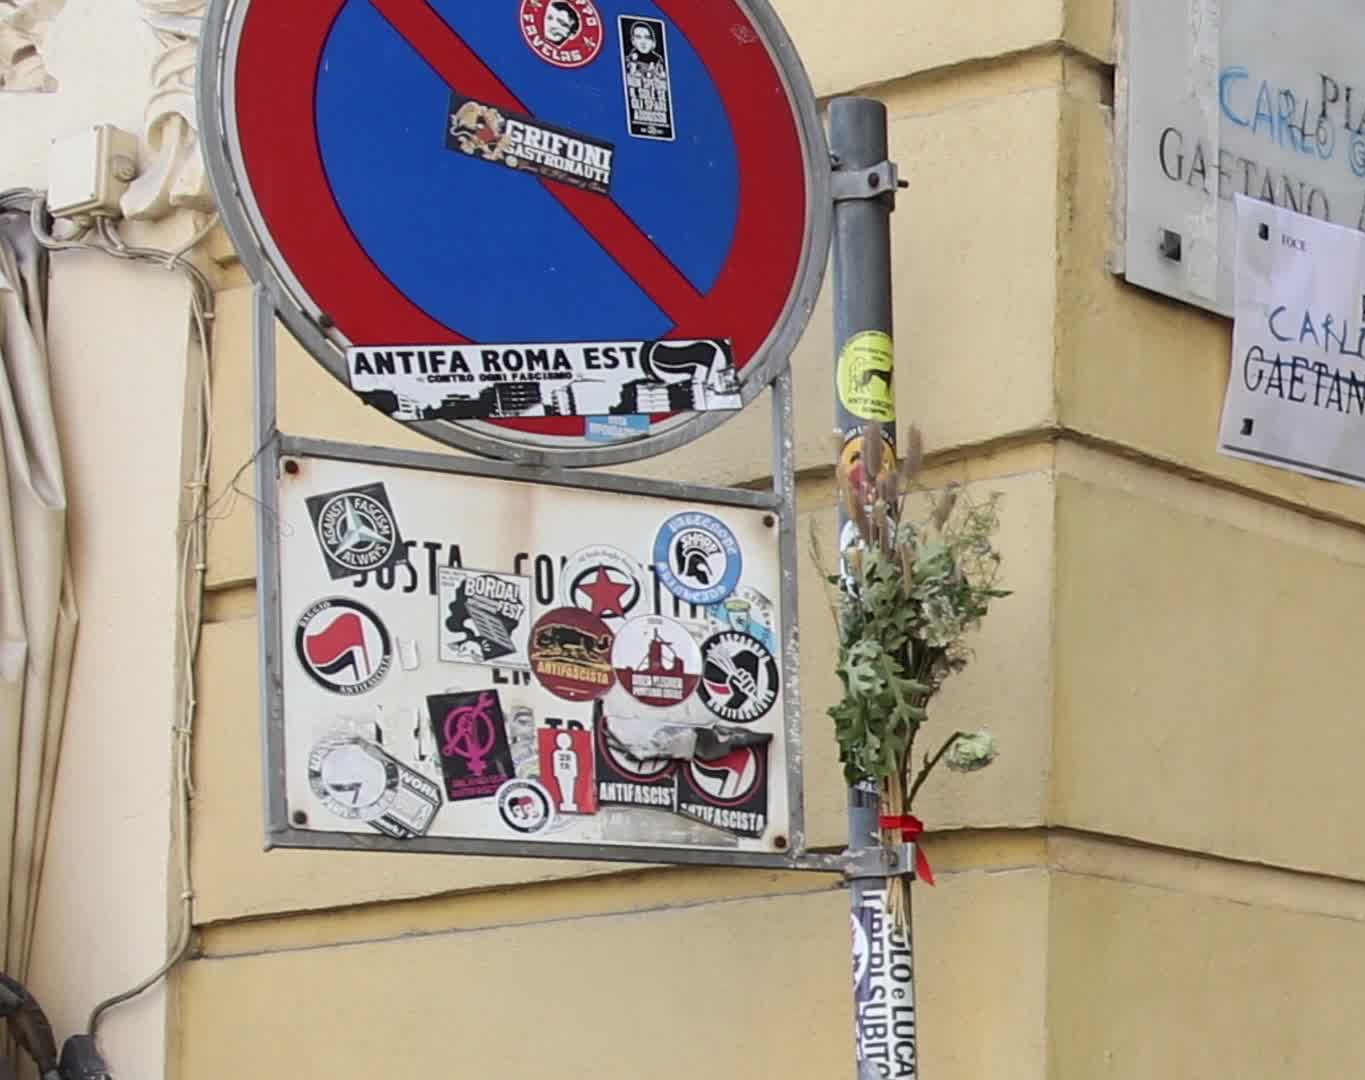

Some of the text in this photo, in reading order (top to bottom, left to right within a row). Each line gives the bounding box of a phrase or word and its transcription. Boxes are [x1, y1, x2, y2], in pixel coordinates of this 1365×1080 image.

[505, 119, 613, 171] GRIFONI
[353, 346, 638, 376] ANTIFA ROMA EST
[323, 497, 390, 566] AGAINST FASCISM ALWAYS
[464, 576, 521, 603] BORDA!
[496, 600, 525, 621] FEST
[537, 661, 610, 685] ANTIFASCISTA
[600, 781, 676, 807] ANTIFASCIST
[890, 1005, 916, 1079] LUCA
